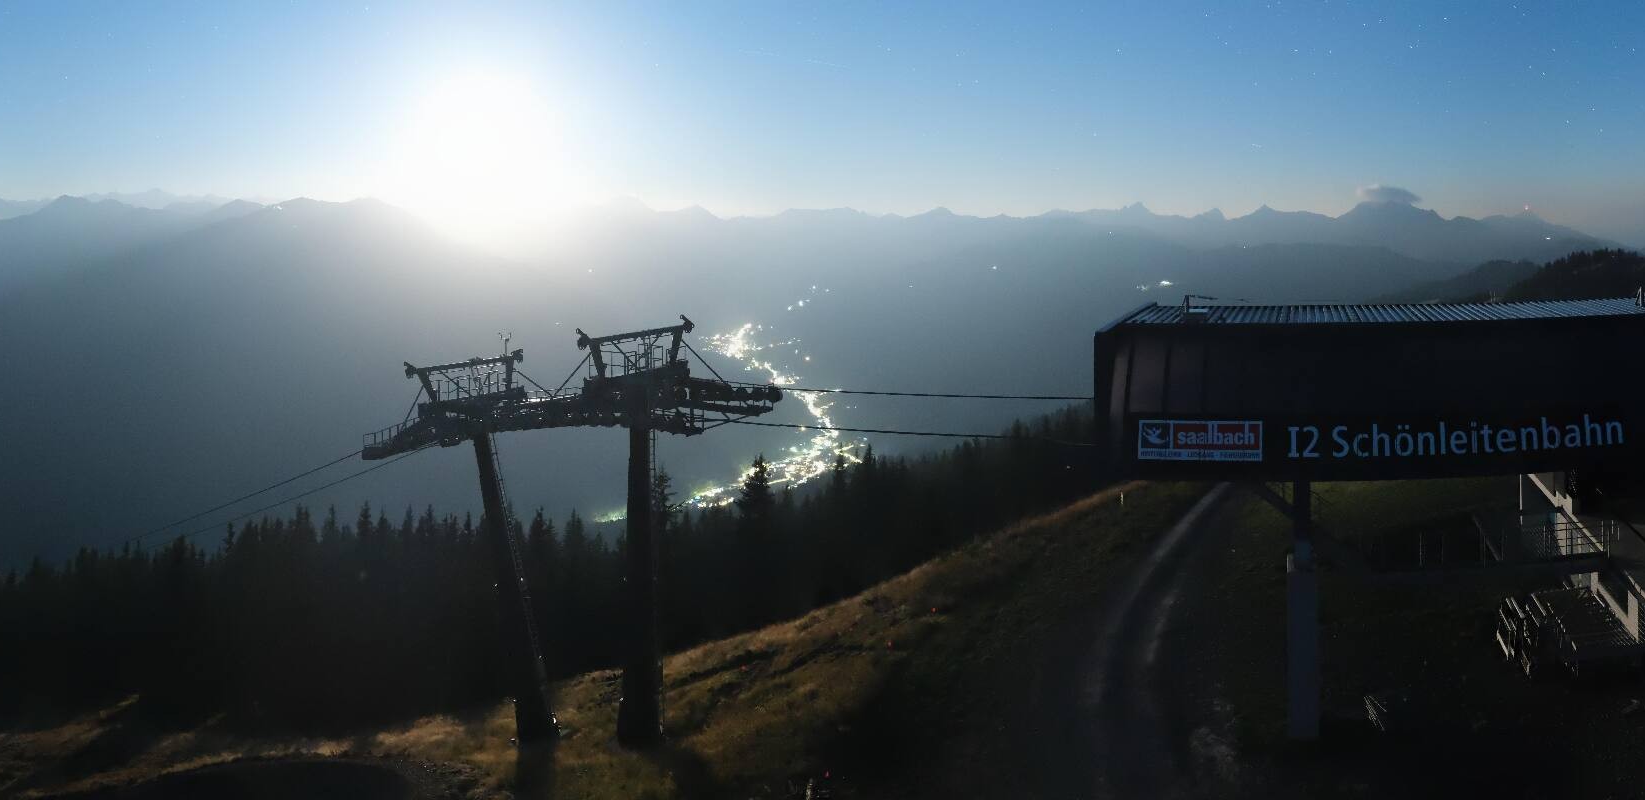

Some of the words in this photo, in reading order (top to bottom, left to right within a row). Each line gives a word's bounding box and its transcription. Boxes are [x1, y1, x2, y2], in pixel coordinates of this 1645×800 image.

[1177, 421, 1255, 446] saalbach
[1287, 425, 1321, 458] I2
[1331, 413, 1625, 458] Schönleitenbahn
